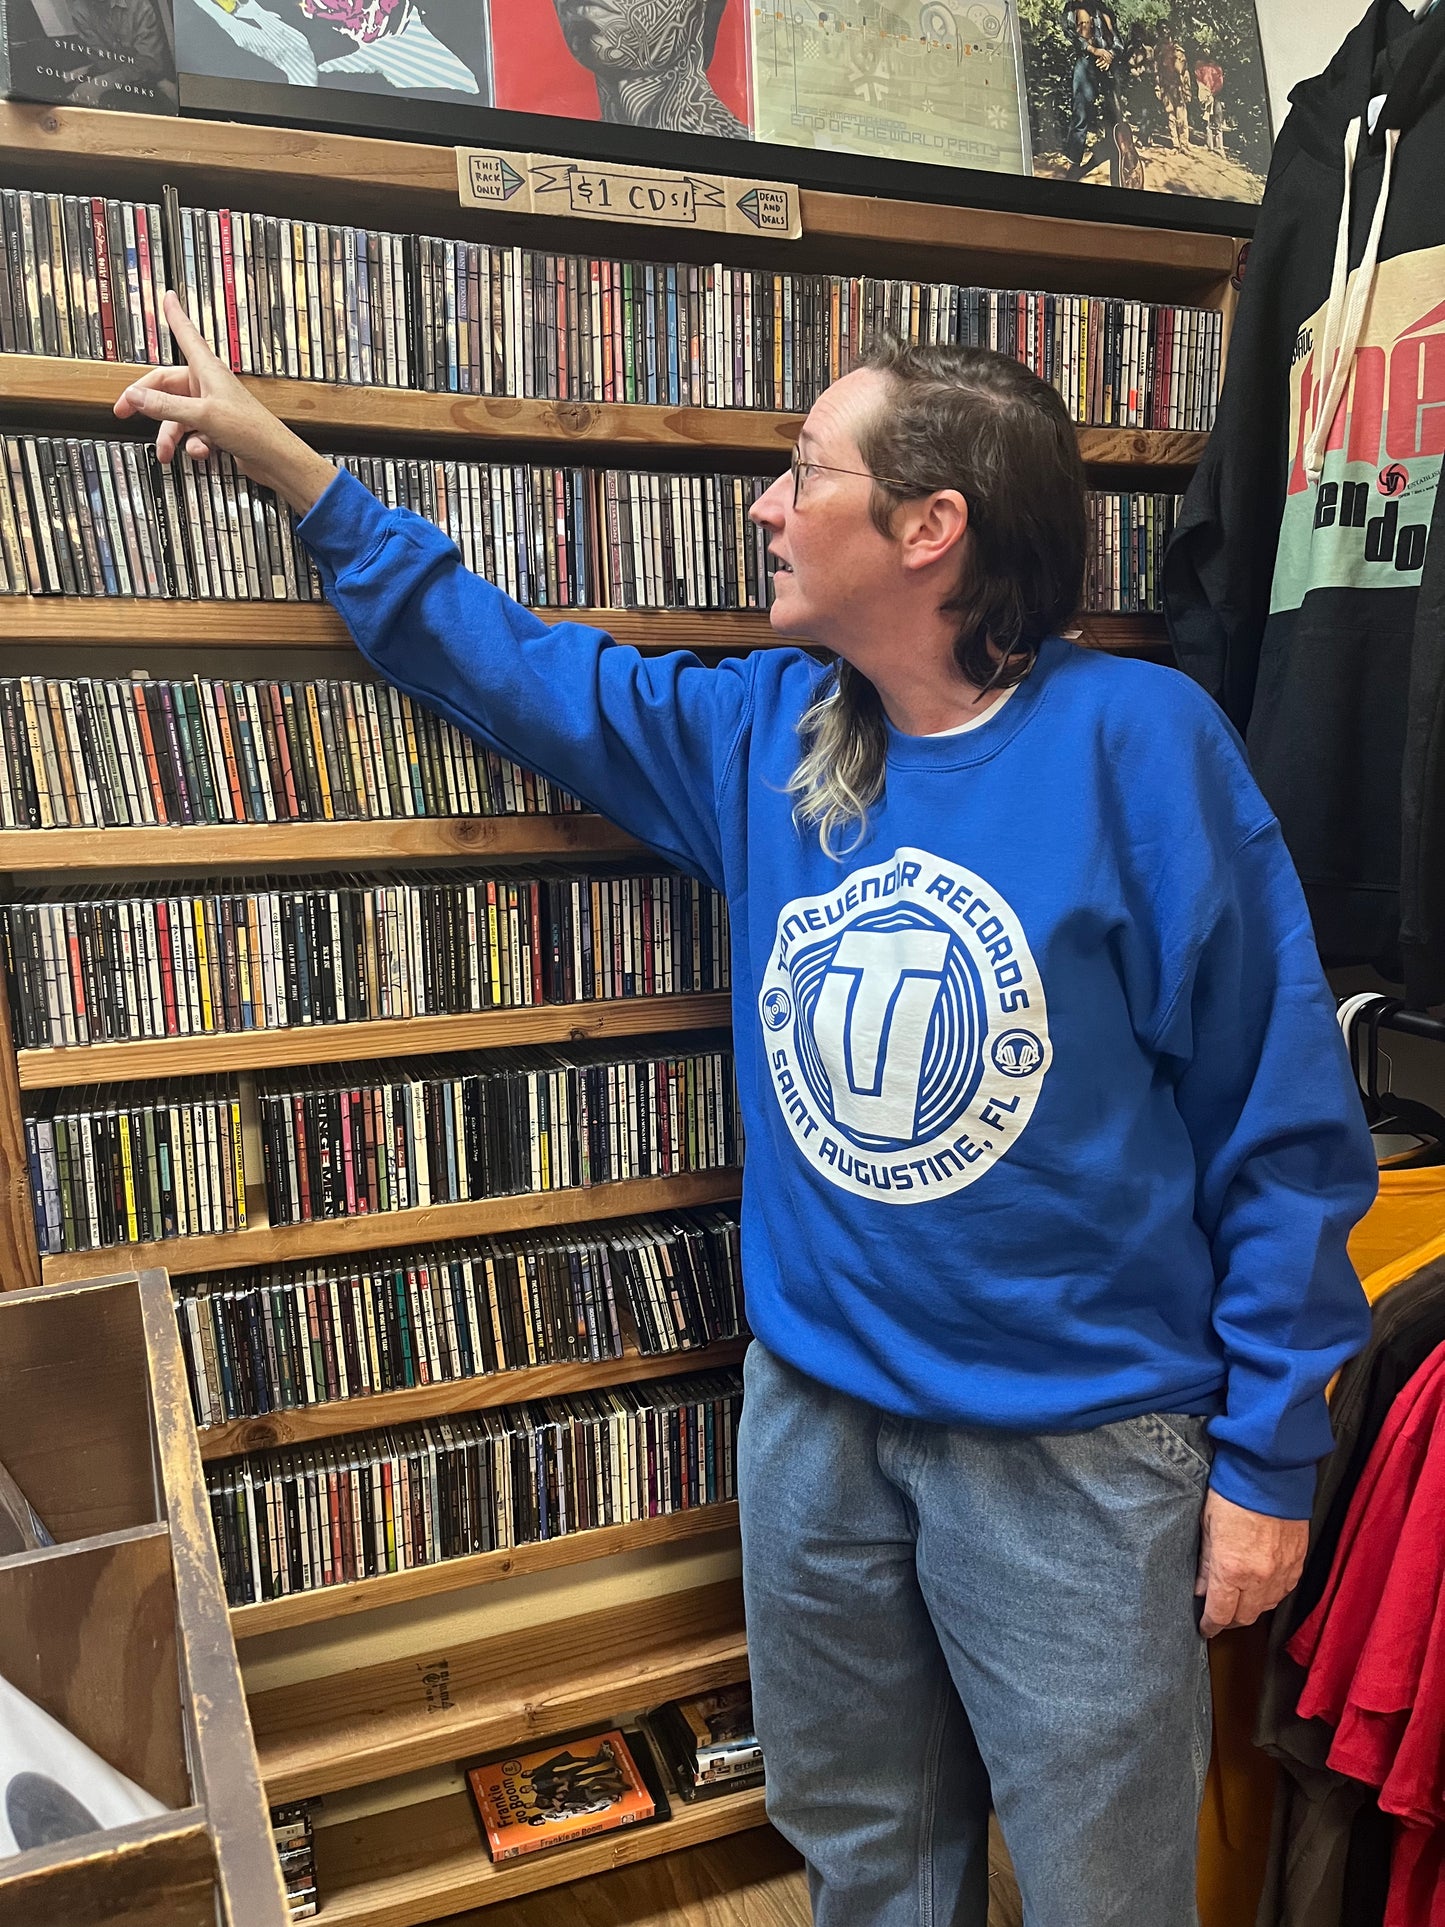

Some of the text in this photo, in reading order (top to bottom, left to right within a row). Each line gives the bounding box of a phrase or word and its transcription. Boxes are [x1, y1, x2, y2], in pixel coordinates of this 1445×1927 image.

[54, 40, 135, 65] STEVE REICH
[36, 65, 155, 98] COLLECTED WORKS
[791, 113, 825, 130] END
[829, 118, 851, 133] OF
[854, 122, 888, 140] THE
[890, 127, 944, 149] WORLD
[947, 138, 1001, 156] PARTY
[474, 160, 500, 171] THIS
[475, 172, 501, 183] RACK
[476, 185, 501, 196] ONLY
[577, 175, 612, 208] $1
[760, 192, 784, 204] DEALS
[762, 215, 785, 225] DEALS
[763, 203, 781, 213] AND
[925, 873, 1030, 1013] RECORDS
[772, 1049, 1021, 1190] SAINT AUGUSTINE, FL
[503, 1777, 524, 1810] Boom
[489, 1784, 514, 1829] Frankie
[540, 1833, 570, 1847] Frankie
[581, 1824, 603, 1837] Boom
